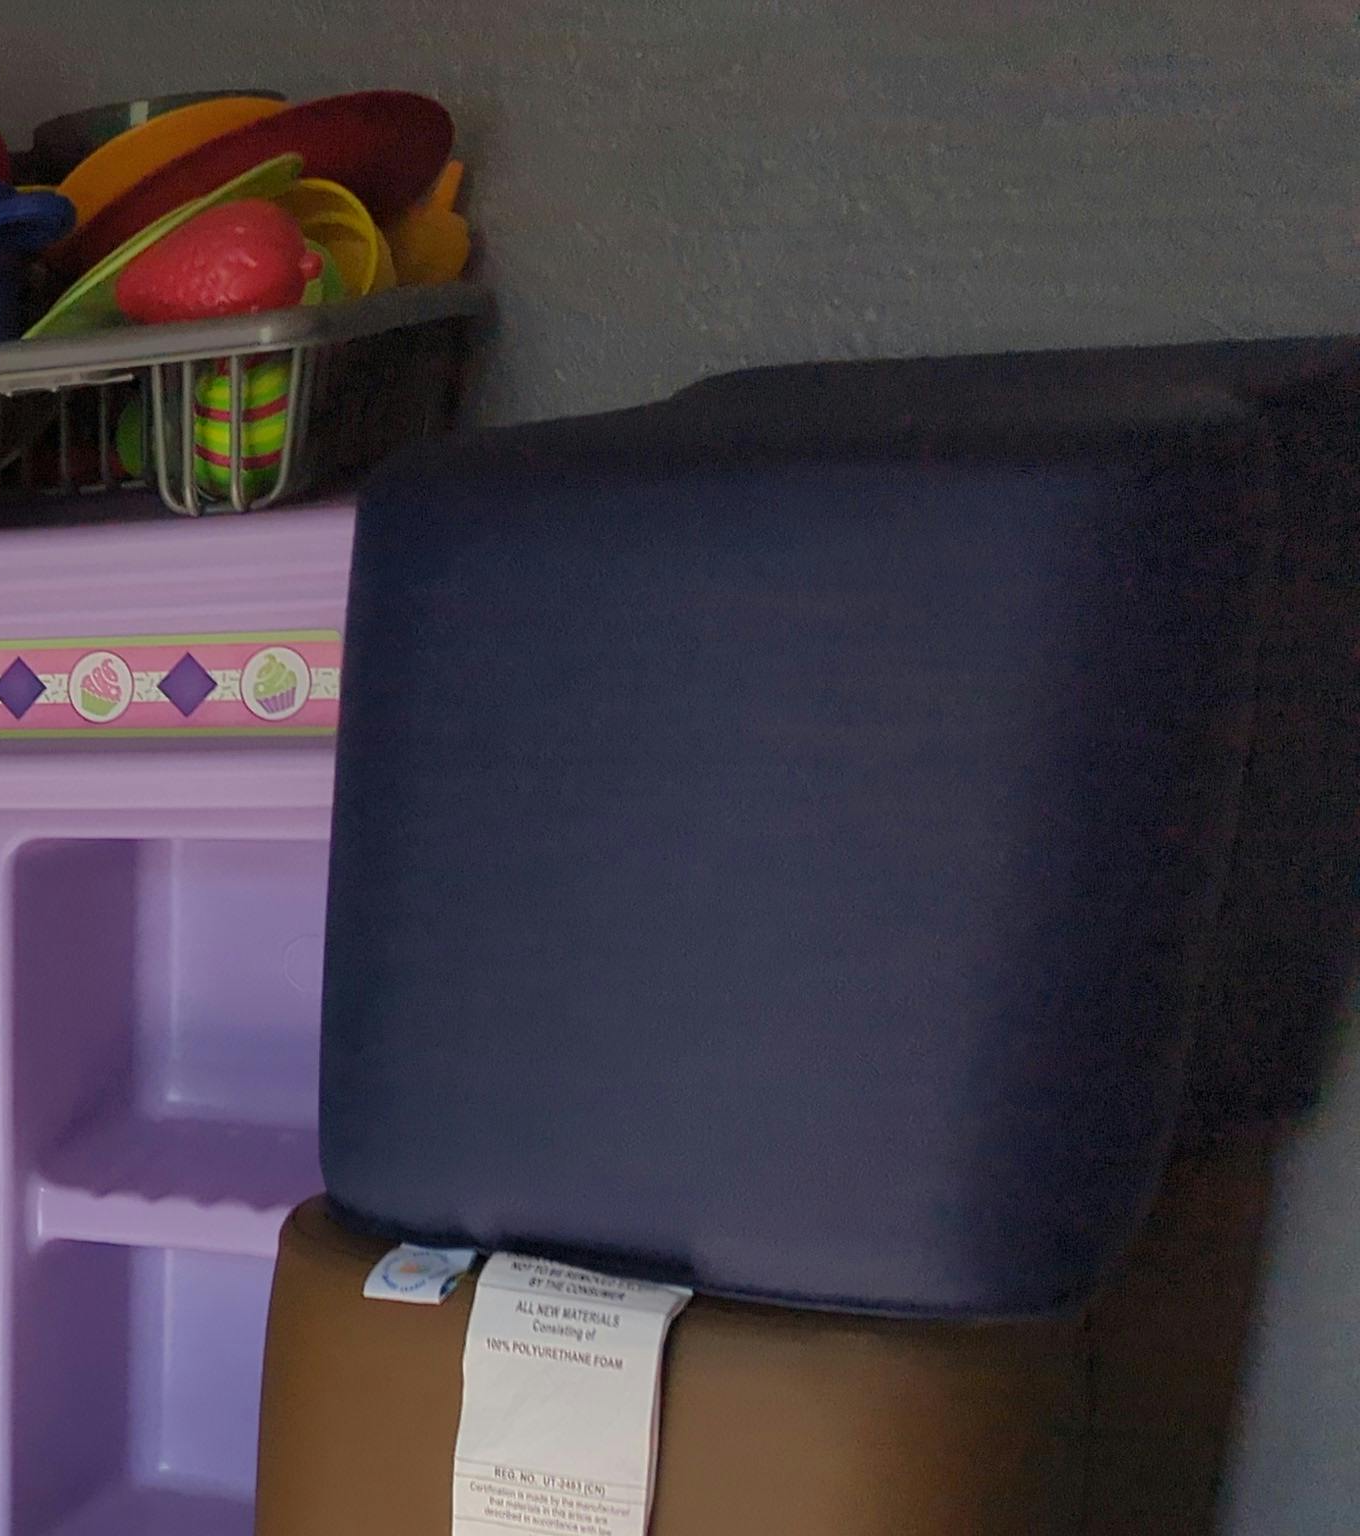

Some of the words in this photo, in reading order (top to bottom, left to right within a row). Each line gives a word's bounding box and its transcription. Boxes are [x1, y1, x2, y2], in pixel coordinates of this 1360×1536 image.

[515, 1299, 534, 1316] ALL
[536, 1303, 561, 1319] NEW
[562, 1306, 621, 1329] MATERIALS
[532, 1318, 583, 1342] Consisting
[584, 1328, 597, 1341] of
[485, 1337, 511, 1353] 100%
[511, 1340, 591, 1367] POLYURETHANE
[592, 1354, 624, 1370] FOAM
